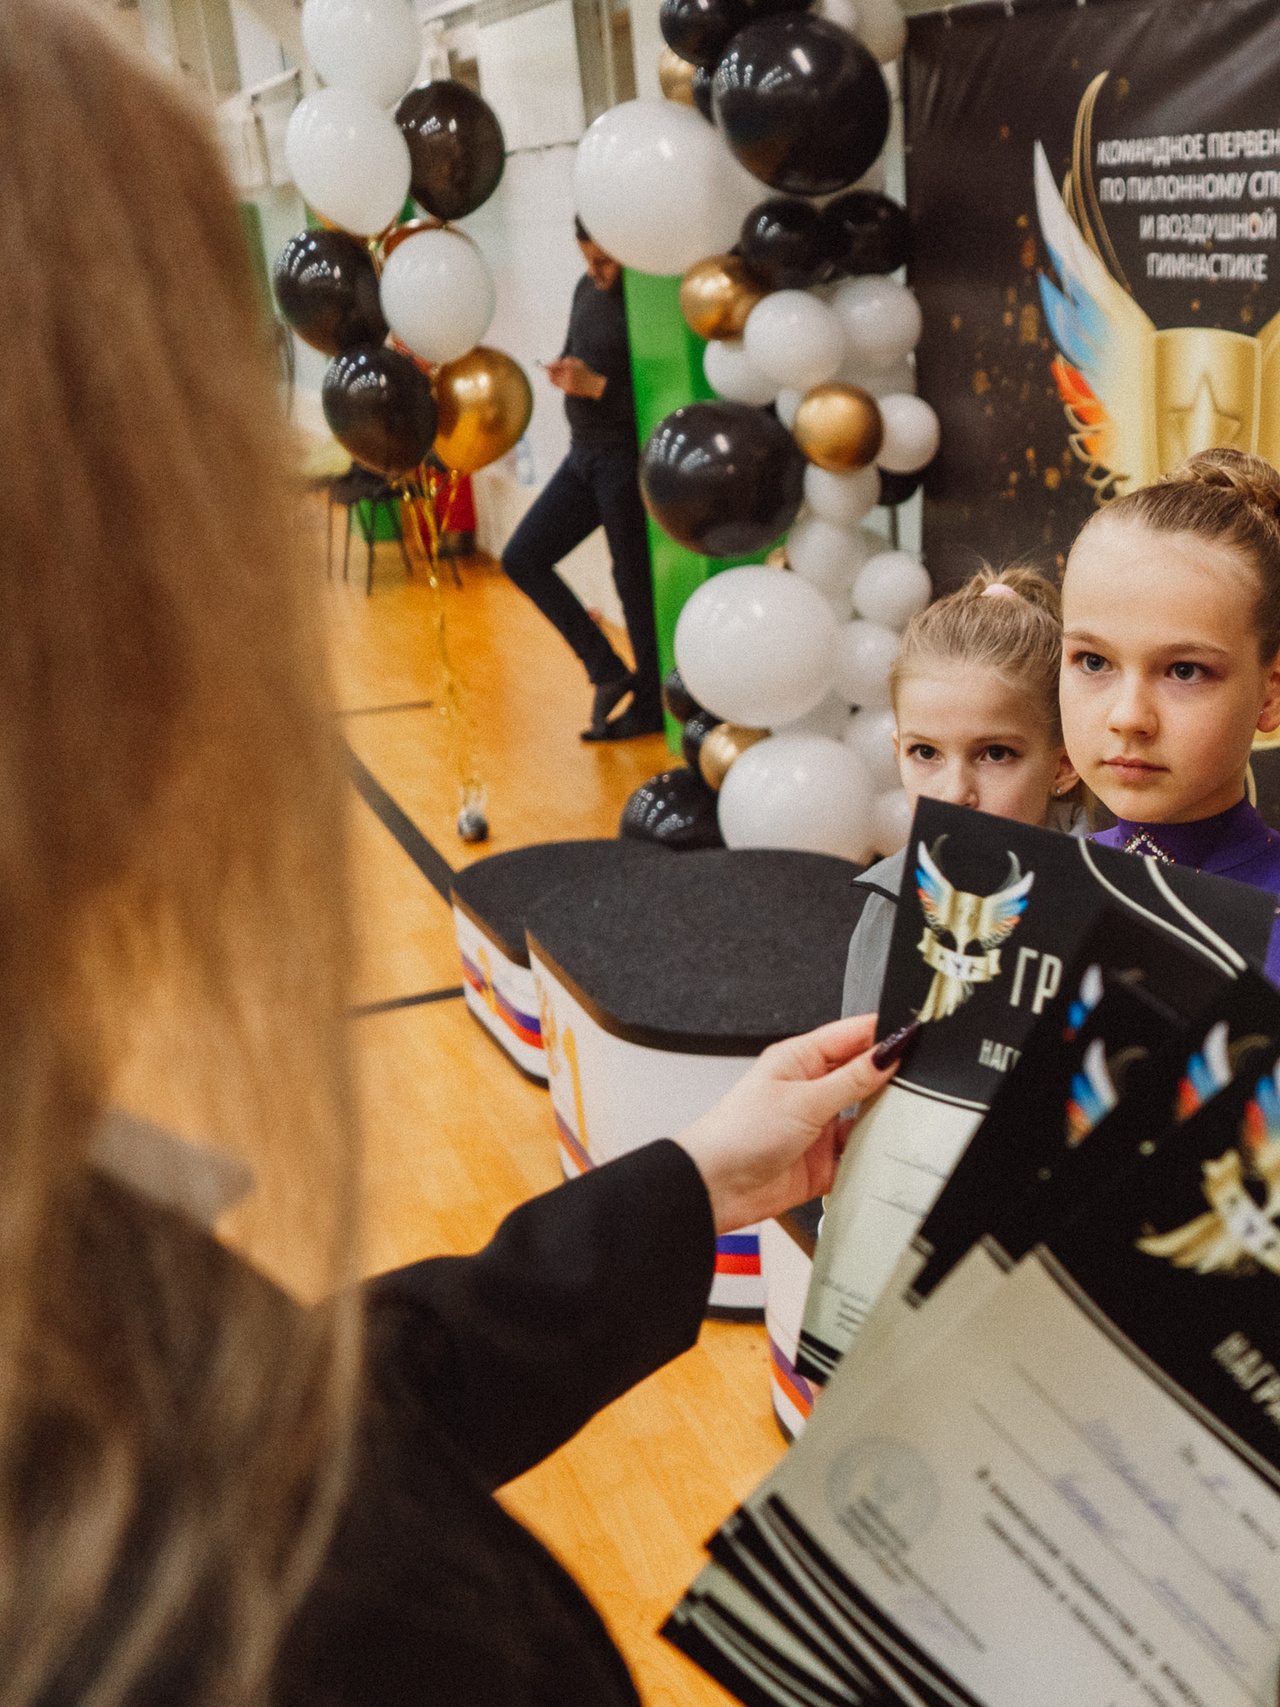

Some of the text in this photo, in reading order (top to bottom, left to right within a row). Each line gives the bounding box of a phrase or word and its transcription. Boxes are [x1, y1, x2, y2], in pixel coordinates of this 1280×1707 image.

[1097, 134, 1205, 167] КОМАНДНОЕ
[1100, 177, 1126, 202] ПО
[1127, 172, 1248, 201] ПИЛОННОМУ
[1139, 206, 1277, 245] И ВОЗДУШНОЙ
[1146, 252, 1268, 281] ГИМНАСТИКЕ
